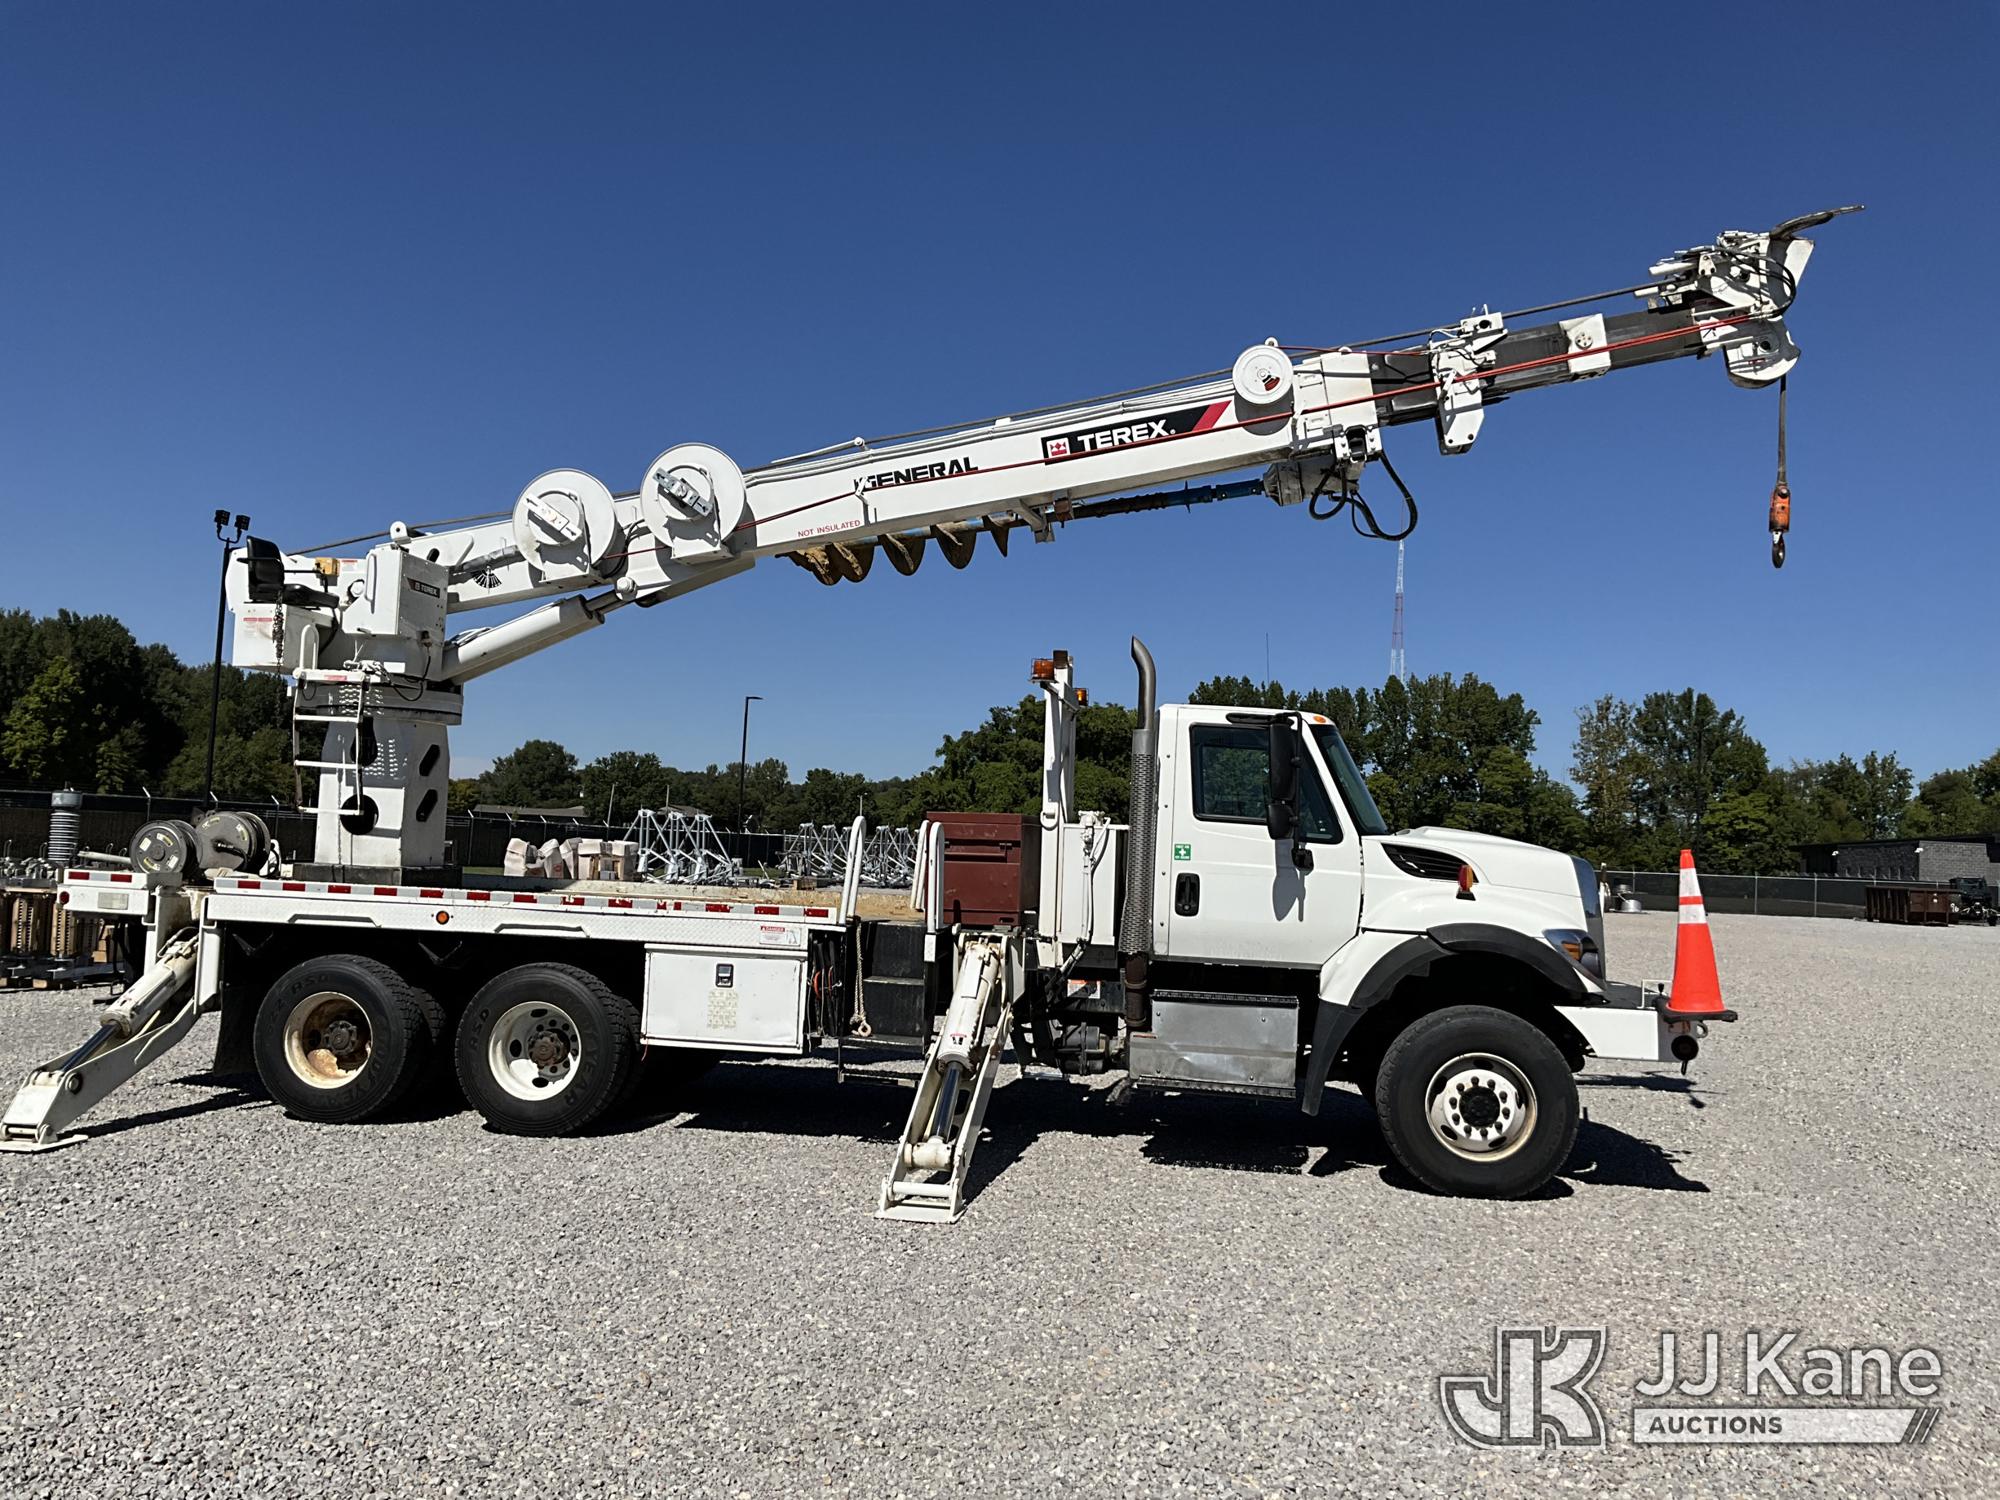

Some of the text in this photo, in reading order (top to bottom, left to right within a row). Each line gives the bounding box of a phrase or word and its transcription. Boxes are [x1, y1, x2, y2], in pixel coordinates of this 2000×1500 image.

[1077, 419, 1171, 452] TEREX
[797, 519, 861, 538] NOT INSULATED
